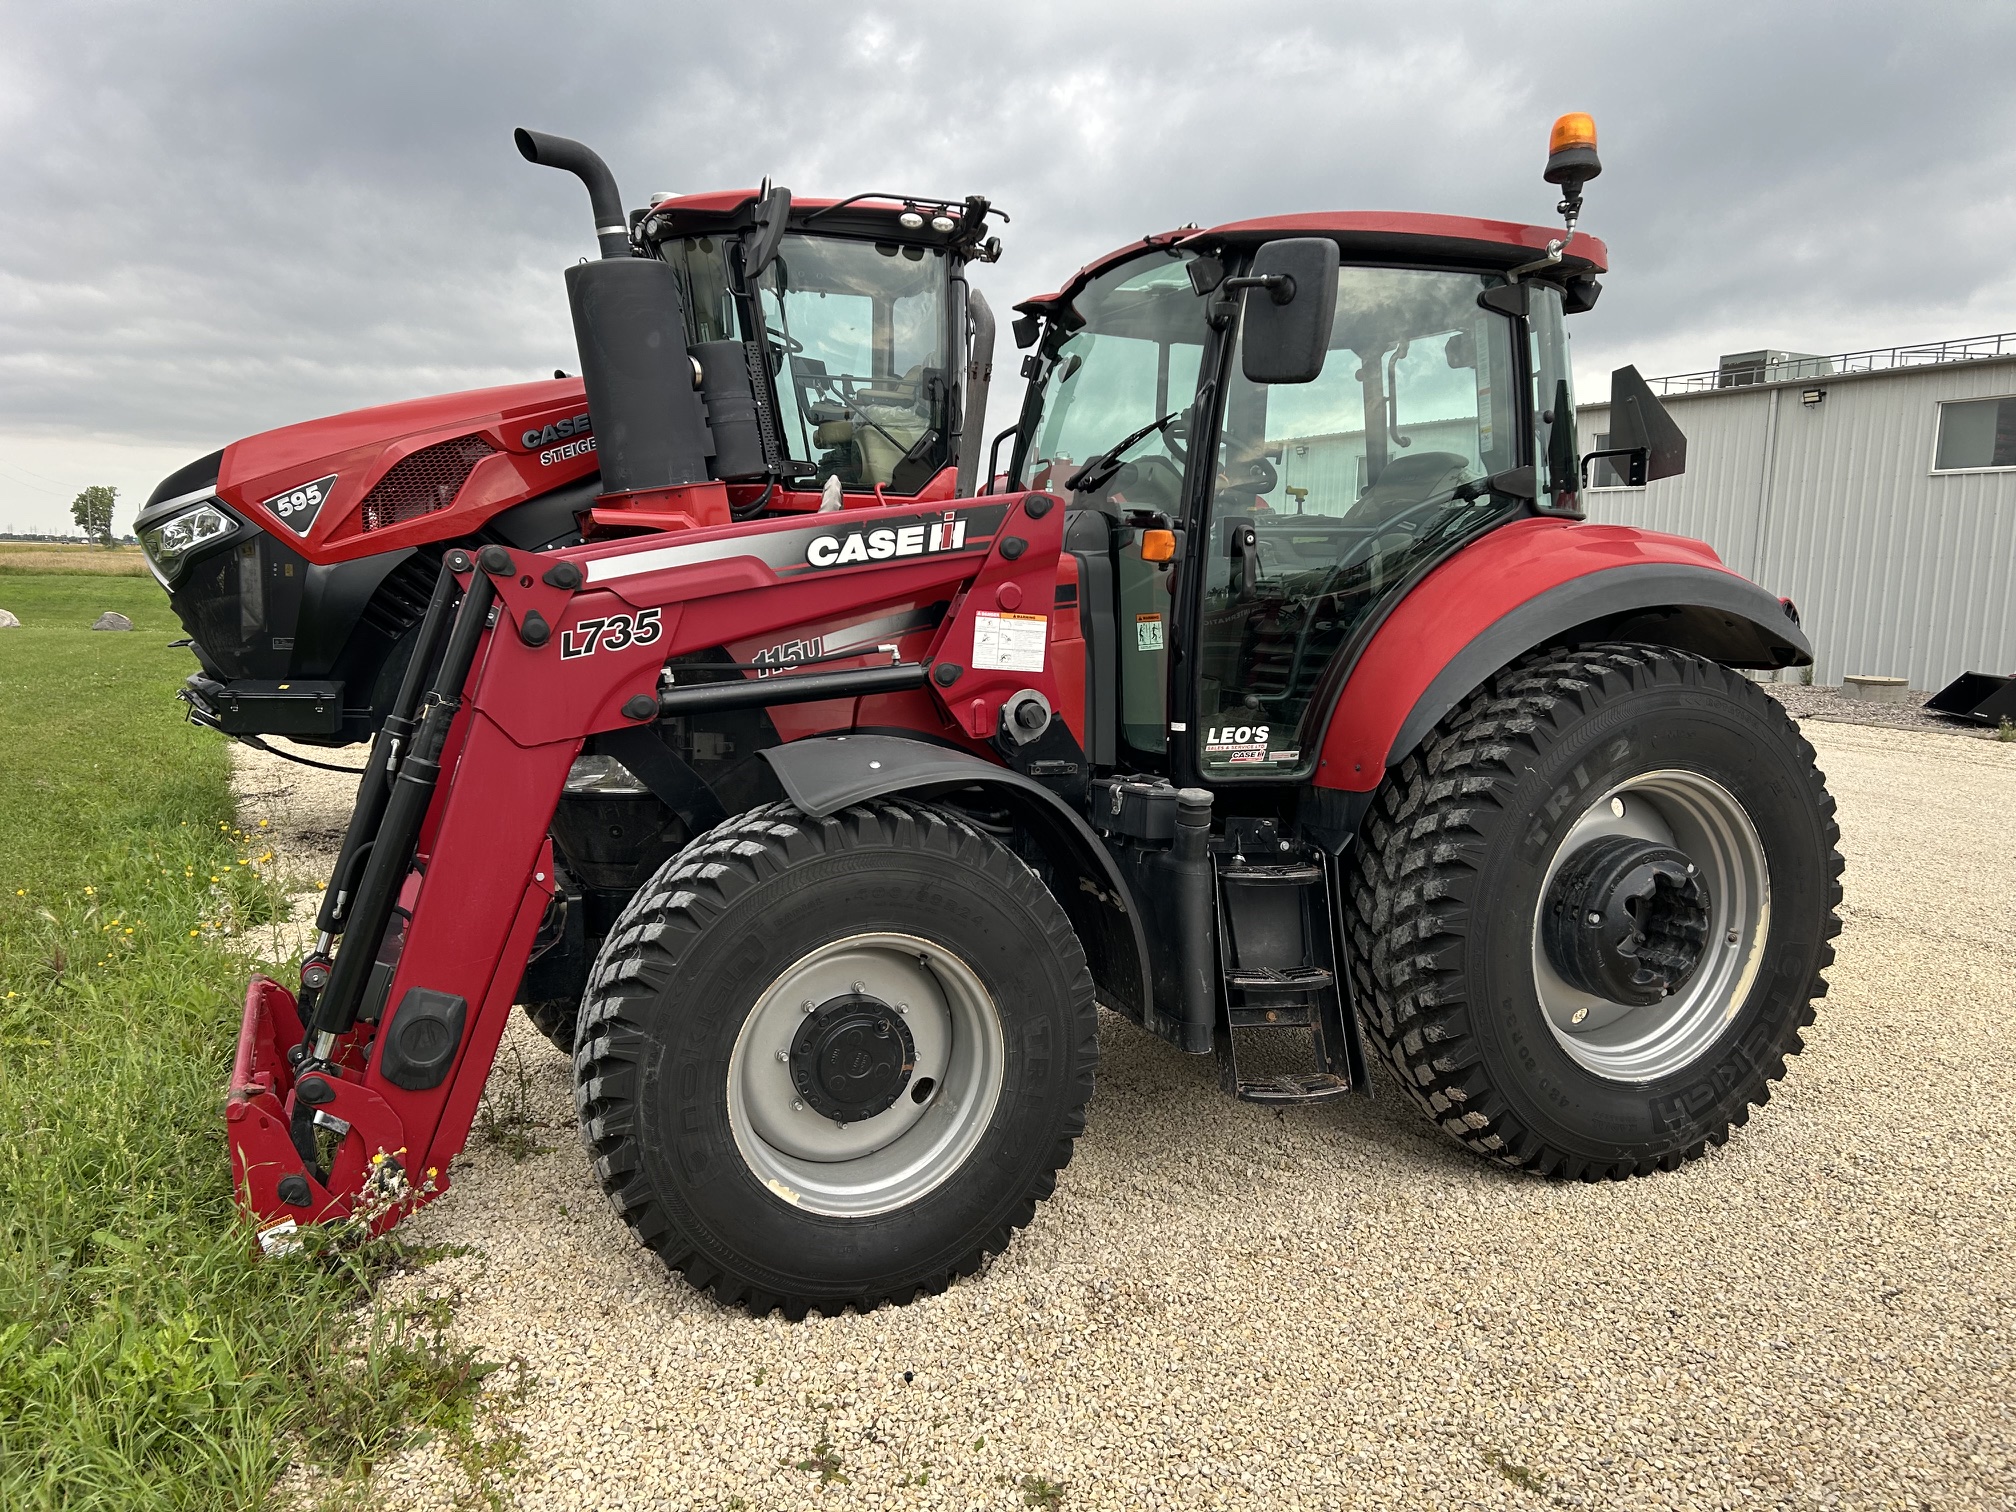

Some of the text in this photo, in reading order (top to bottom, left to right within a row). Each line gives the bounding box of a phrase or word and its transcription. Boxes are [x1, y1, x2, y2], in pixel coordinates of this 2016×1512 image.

[521, 413, 591, 449] CASE
[540, 437, 597, 467] STEIGE
[277, 484, 322, 517] 595
[806, 526, 926, 568] CASE
[561, 607, 662, 660] L735
[752, 637, 822, 678] 115U
[1207, 726, 1270, 744] LEO'S
[1524, 737, 1632, 848] TRI 2
